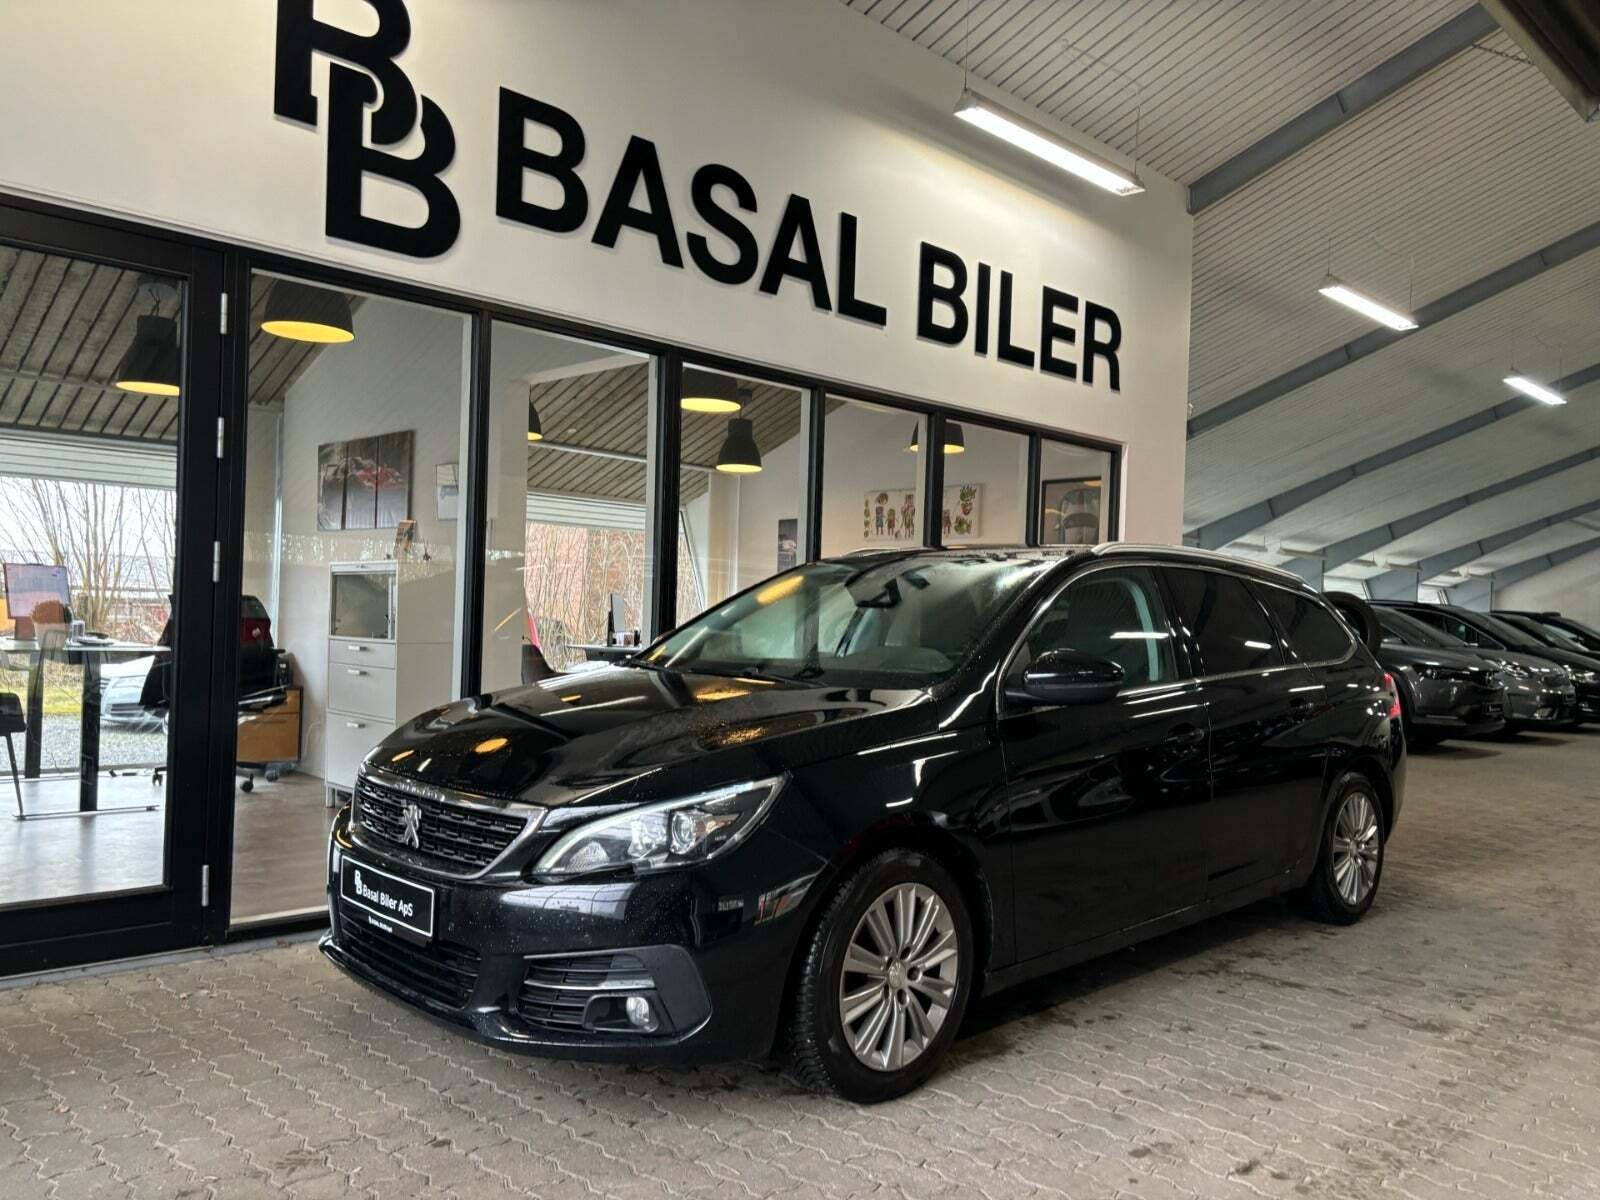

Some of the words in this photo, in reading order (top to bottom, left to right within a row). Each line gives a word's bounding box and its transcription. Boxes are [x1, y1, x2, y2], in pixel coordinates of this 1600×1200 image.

[496, 86, 887, 327] BASAL
[917, 241, 1123, 391] BILER
[363, 884, 379, 903] Basal
[380, 892, 398, 910] Biler
[398, 899, 413, 917] ApS
